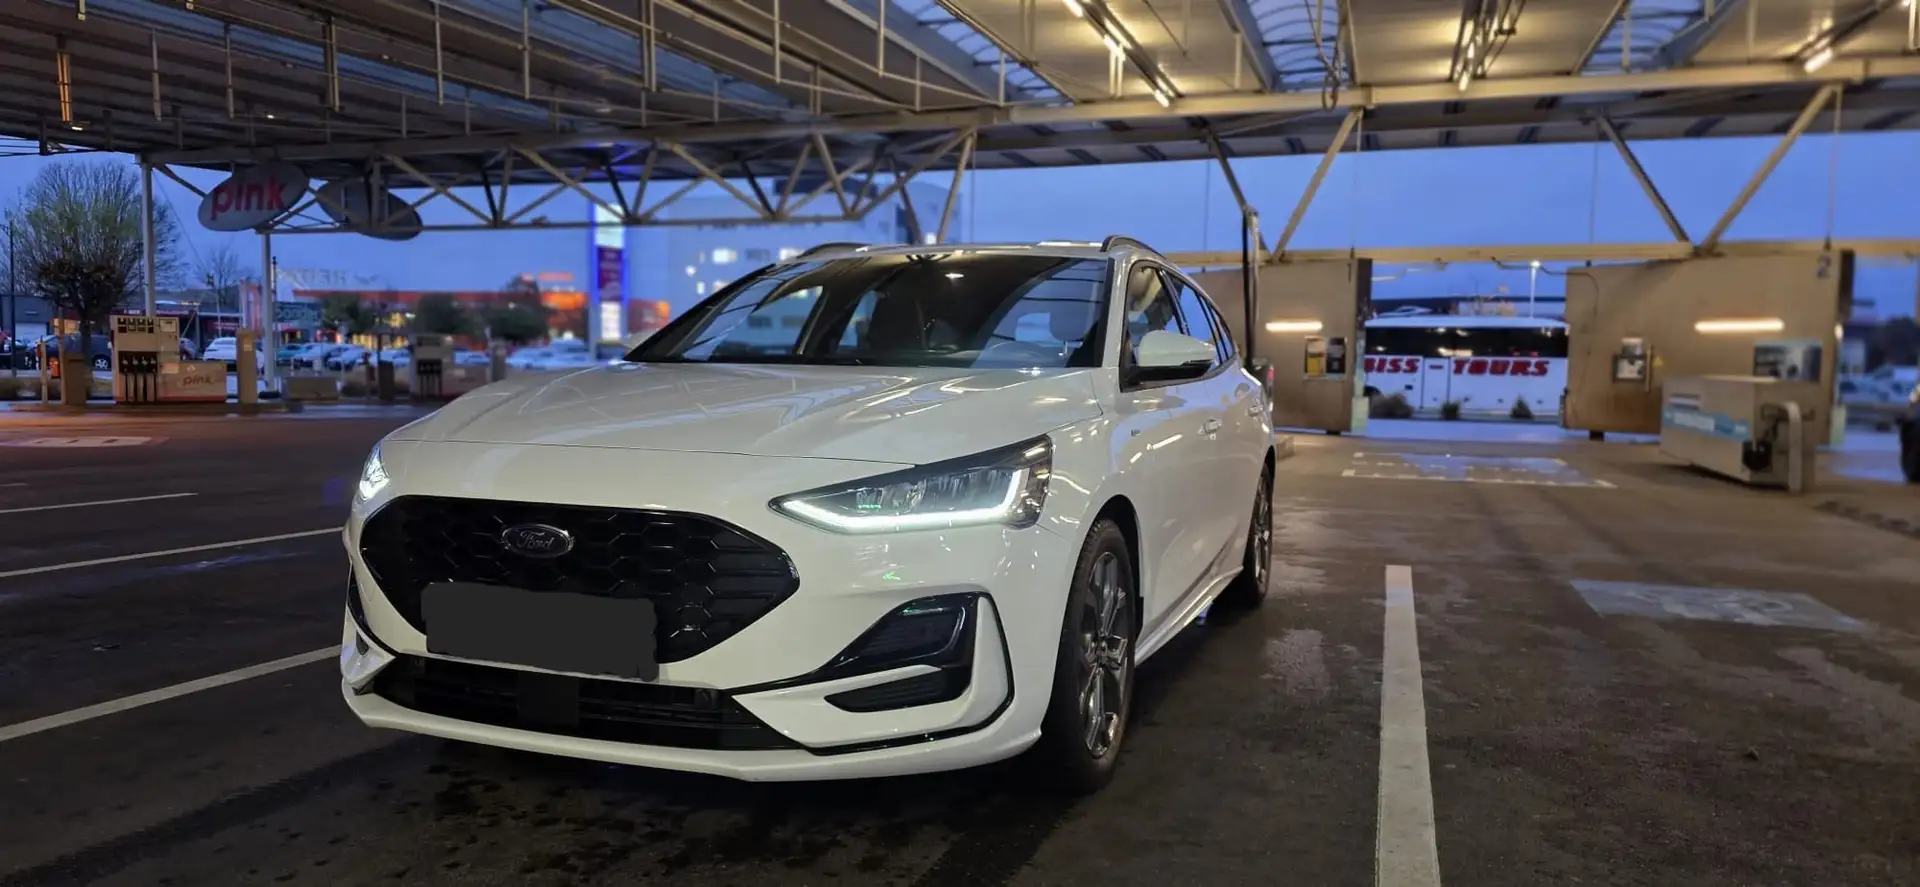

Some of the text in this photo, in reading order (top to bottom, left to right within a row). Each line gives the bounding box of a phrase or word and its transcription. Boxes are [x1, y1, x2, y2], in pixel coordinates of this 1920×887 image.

[210, 175, 287, 220] pink
[1453, 359, 1550, 377] TOURS
[516, 530, 556, 549] Ford
